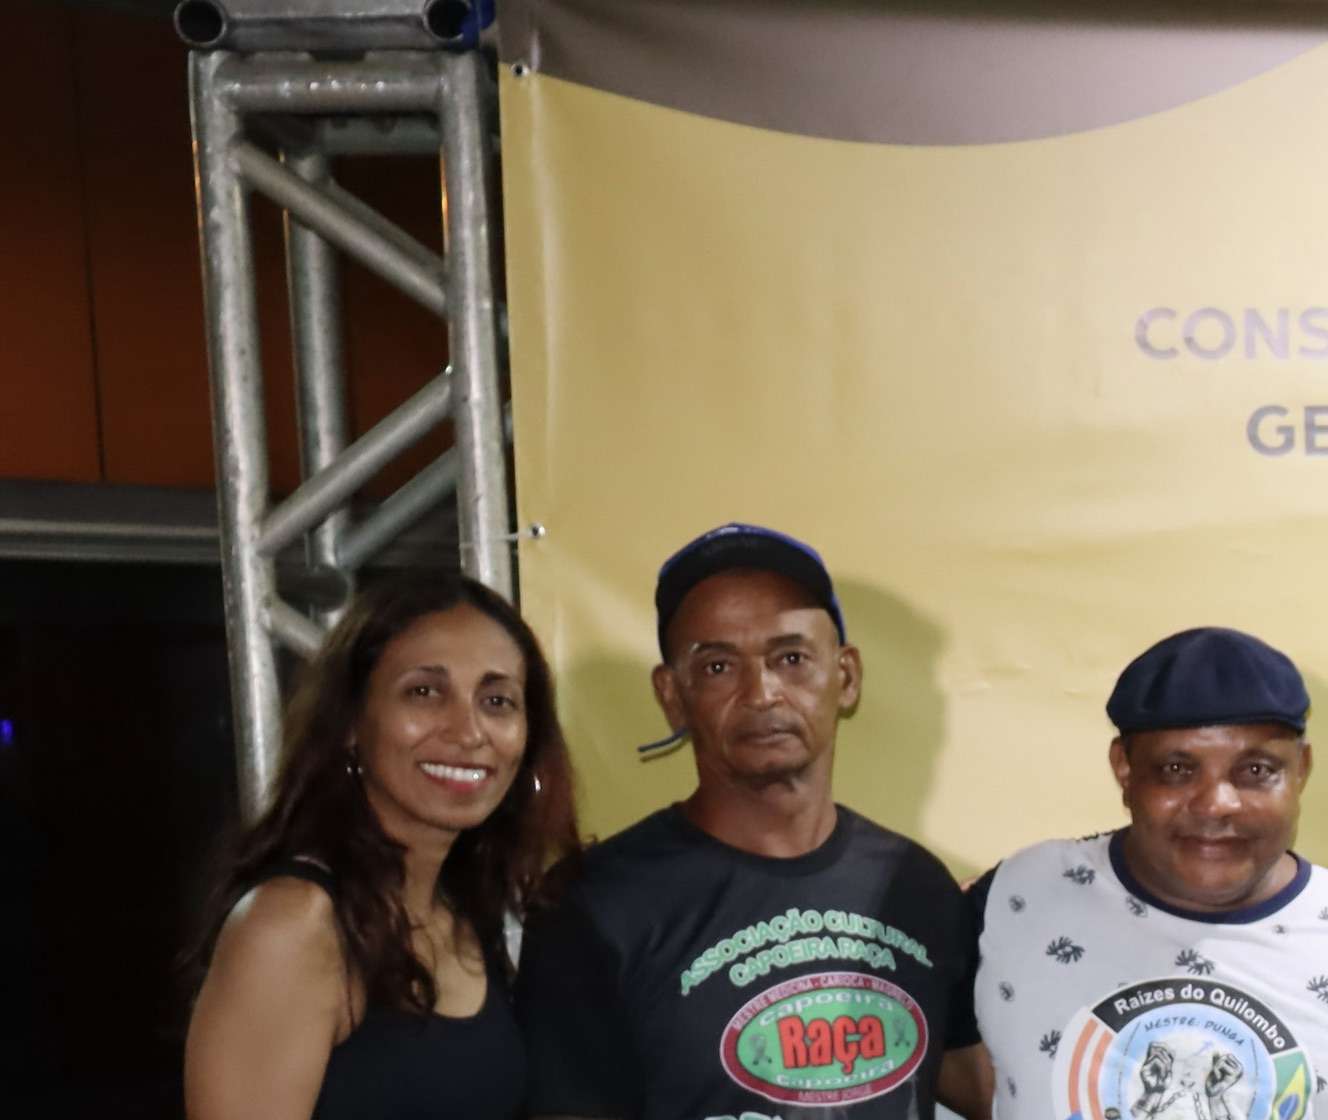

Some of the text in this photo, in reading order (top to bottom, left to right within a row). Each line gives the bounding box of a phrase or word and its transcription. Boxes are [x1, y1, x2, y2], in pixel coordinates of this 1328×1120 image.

[729, 935, 840, 987] CAPOEIRA
[822, 908, 934, 968] CULTURAL
[776, 1014, 887, 1076] Raça
[1113, 983, 1287, 1050] Raízes do Quilombo
